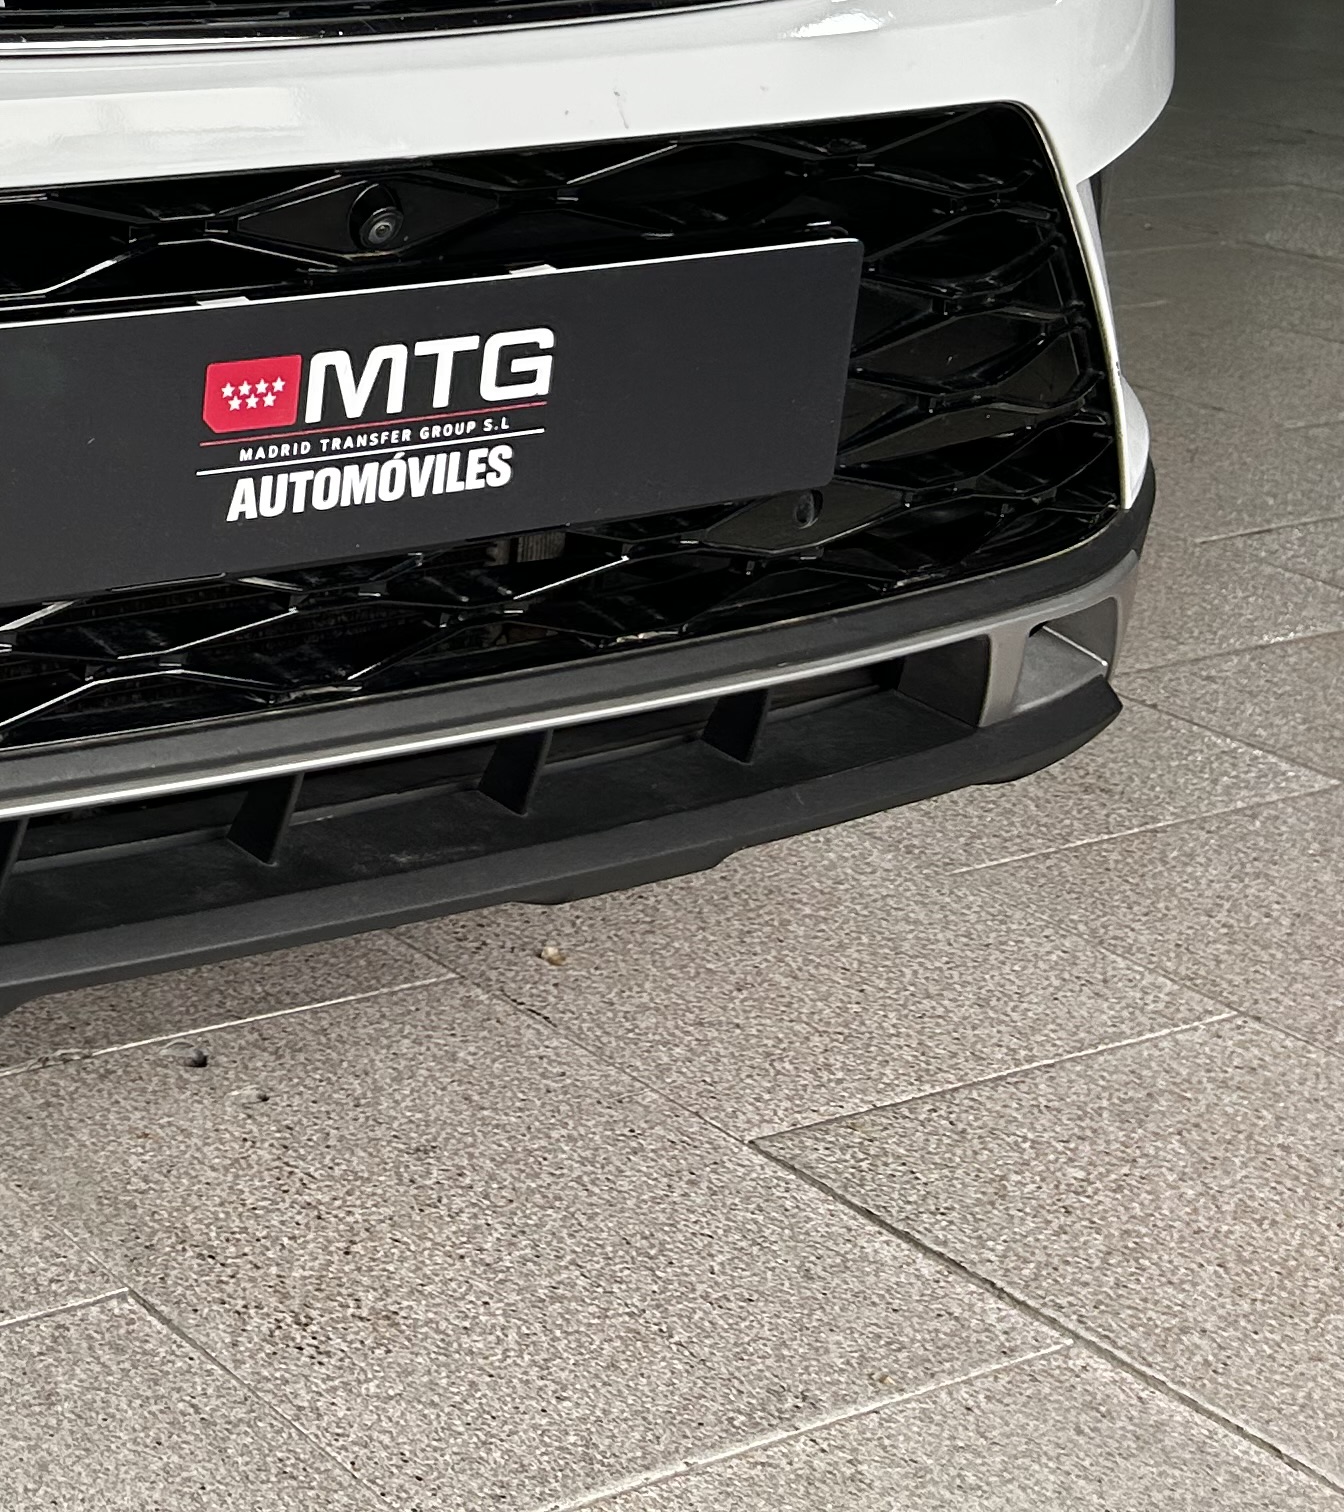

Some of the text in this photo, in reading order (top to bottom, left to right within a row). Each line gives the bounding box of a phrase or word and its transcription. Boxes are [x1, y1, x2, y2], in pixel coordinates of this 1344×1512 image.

[304, 327, 555, 424] MTG
[239, 416, 510, 462] MADRID TRANSFER GROUP S.L
[226, 444, 513, 522] AUTOMÓVILES
